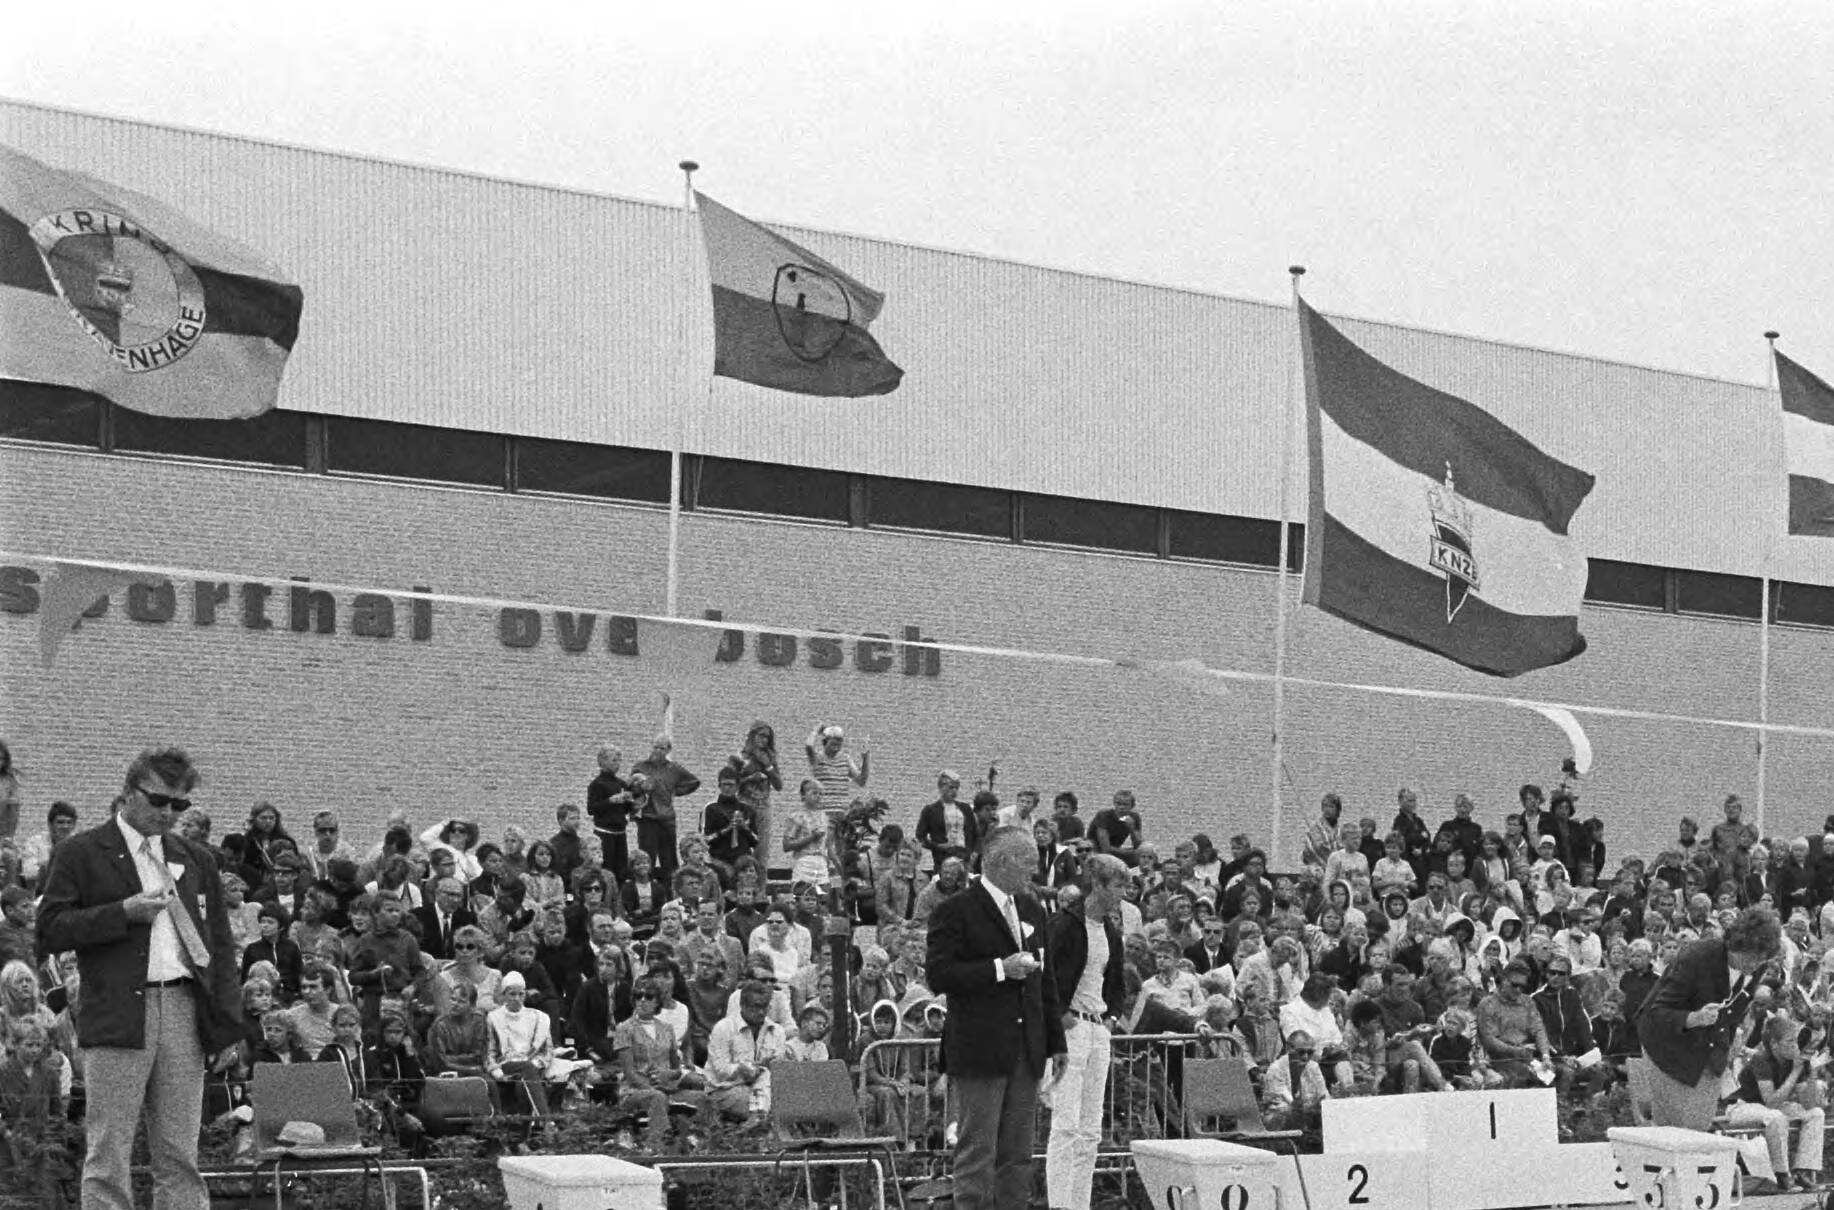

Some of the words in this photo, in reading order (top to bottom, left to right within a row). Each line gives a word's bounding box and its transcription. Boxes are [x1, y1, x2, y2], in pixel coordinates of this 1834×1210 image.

[0, 565, 432, 640] sorthal
[1347, 1163, 1370, 1204] 2
[1696, 1165, 1720, 1210] 3
